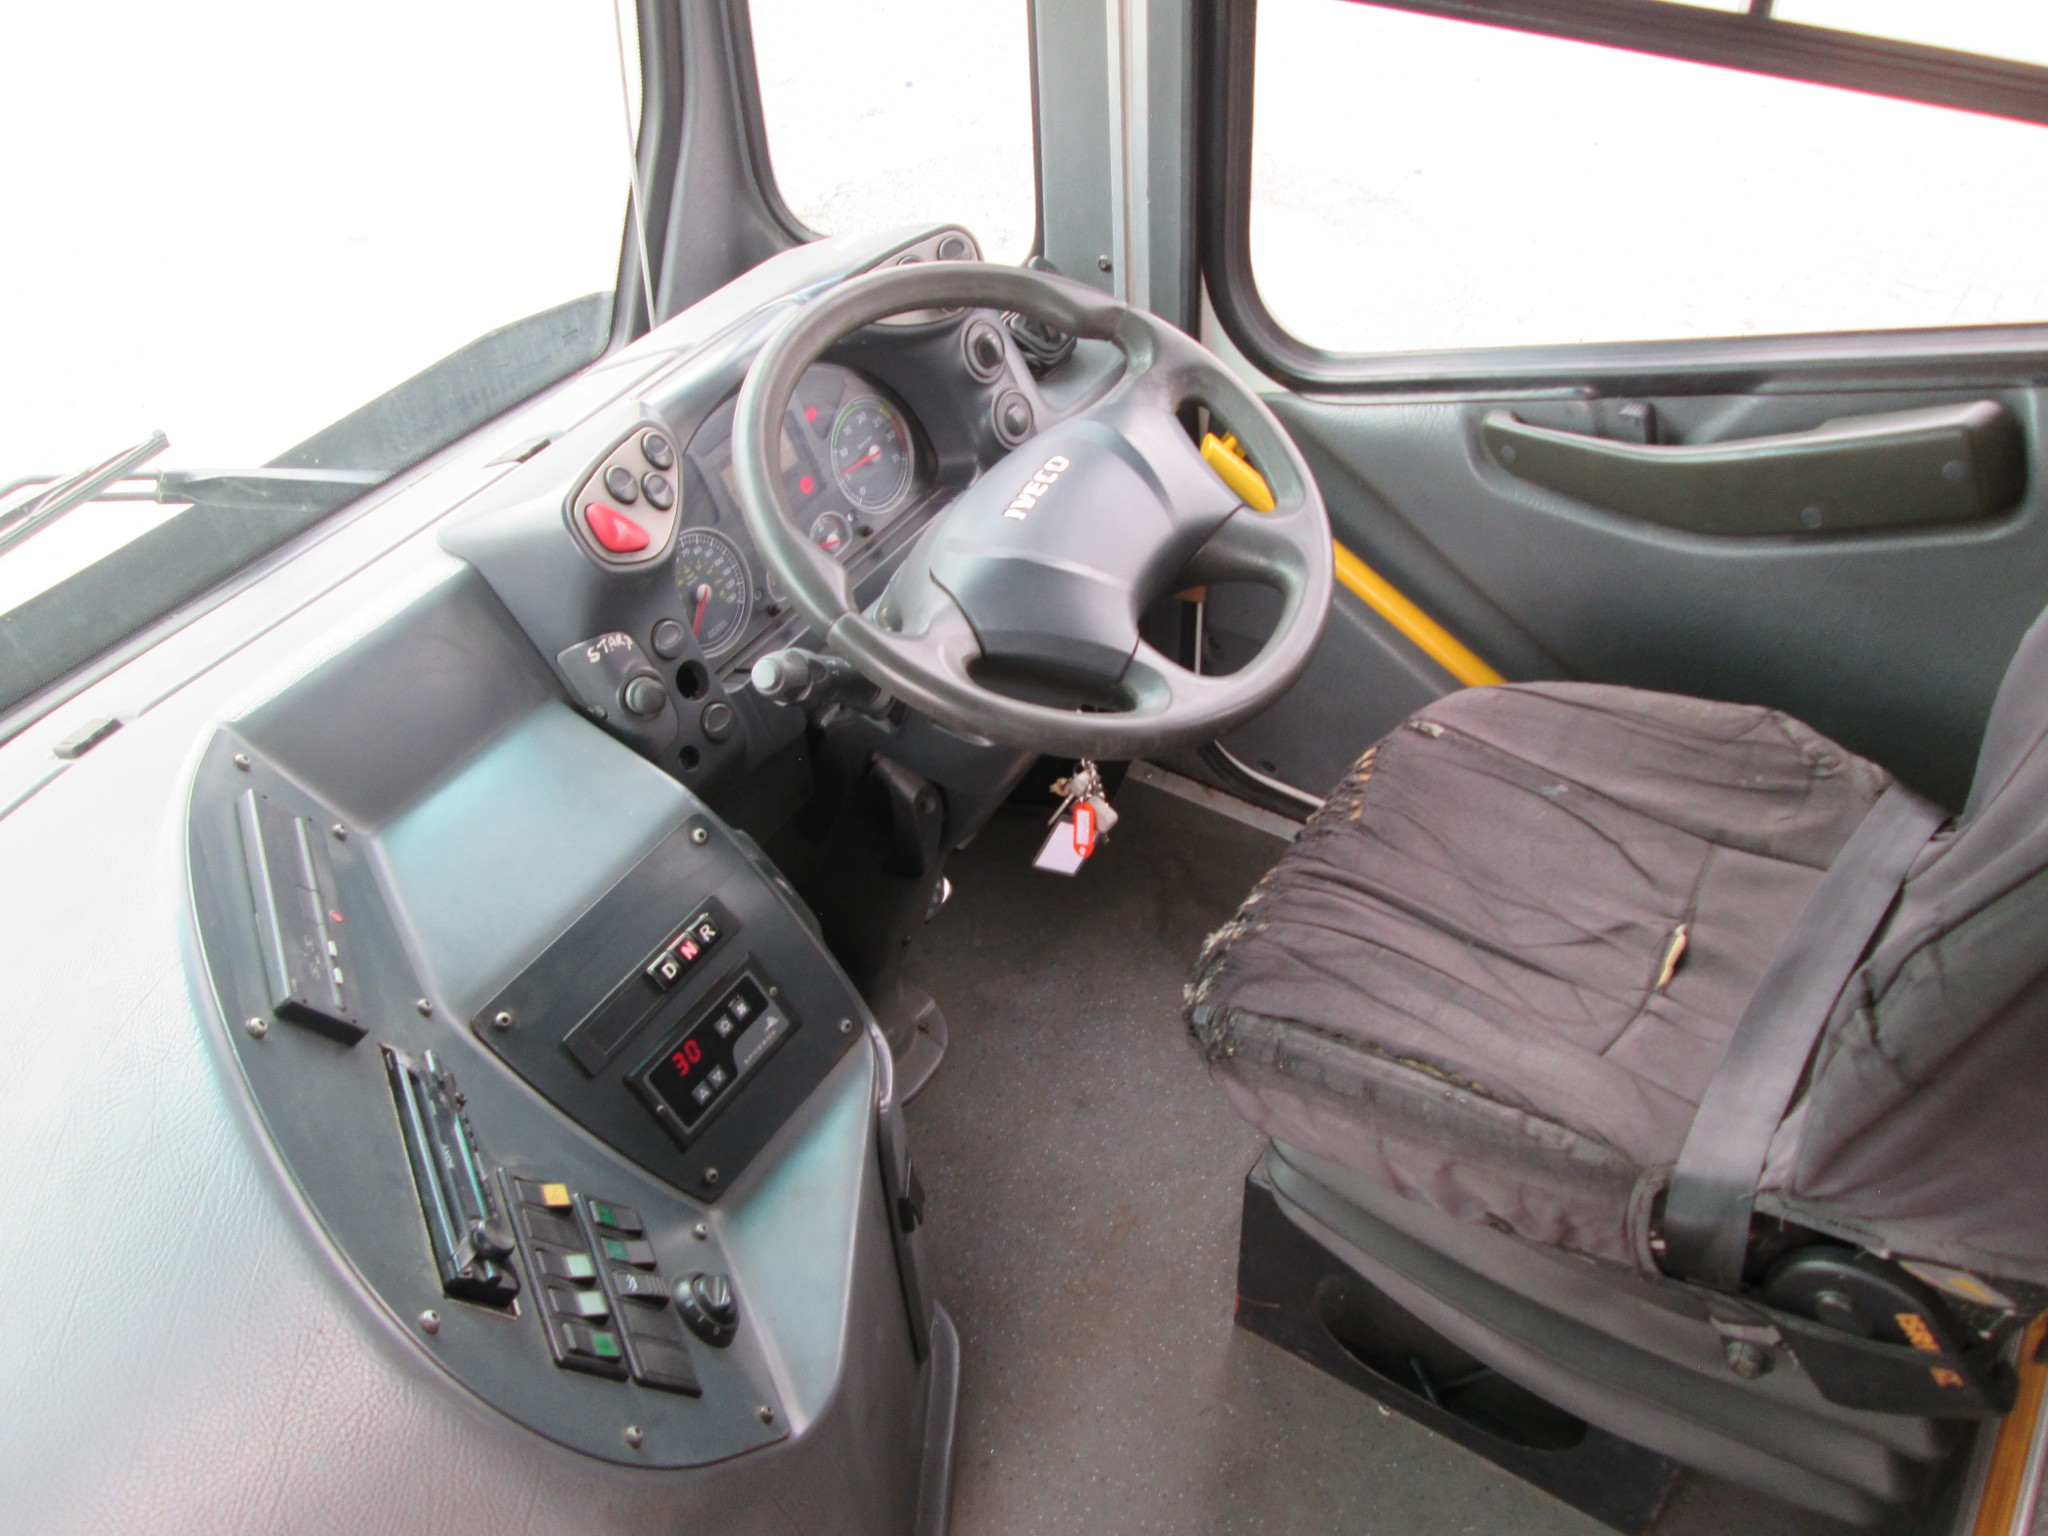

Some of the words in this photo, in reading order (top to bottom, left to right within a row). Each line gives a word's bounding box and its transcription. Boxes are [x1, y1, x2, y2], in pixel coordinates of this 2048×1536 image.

[1003, 455, 1070, 521] IVECO
[587, 633, 633, 663] START
[700, 924, 716, 942] R
[681, 941, 698, 960] N
[661, 962, 677, 980] D
[672, 1039, 703, 1077] 30
